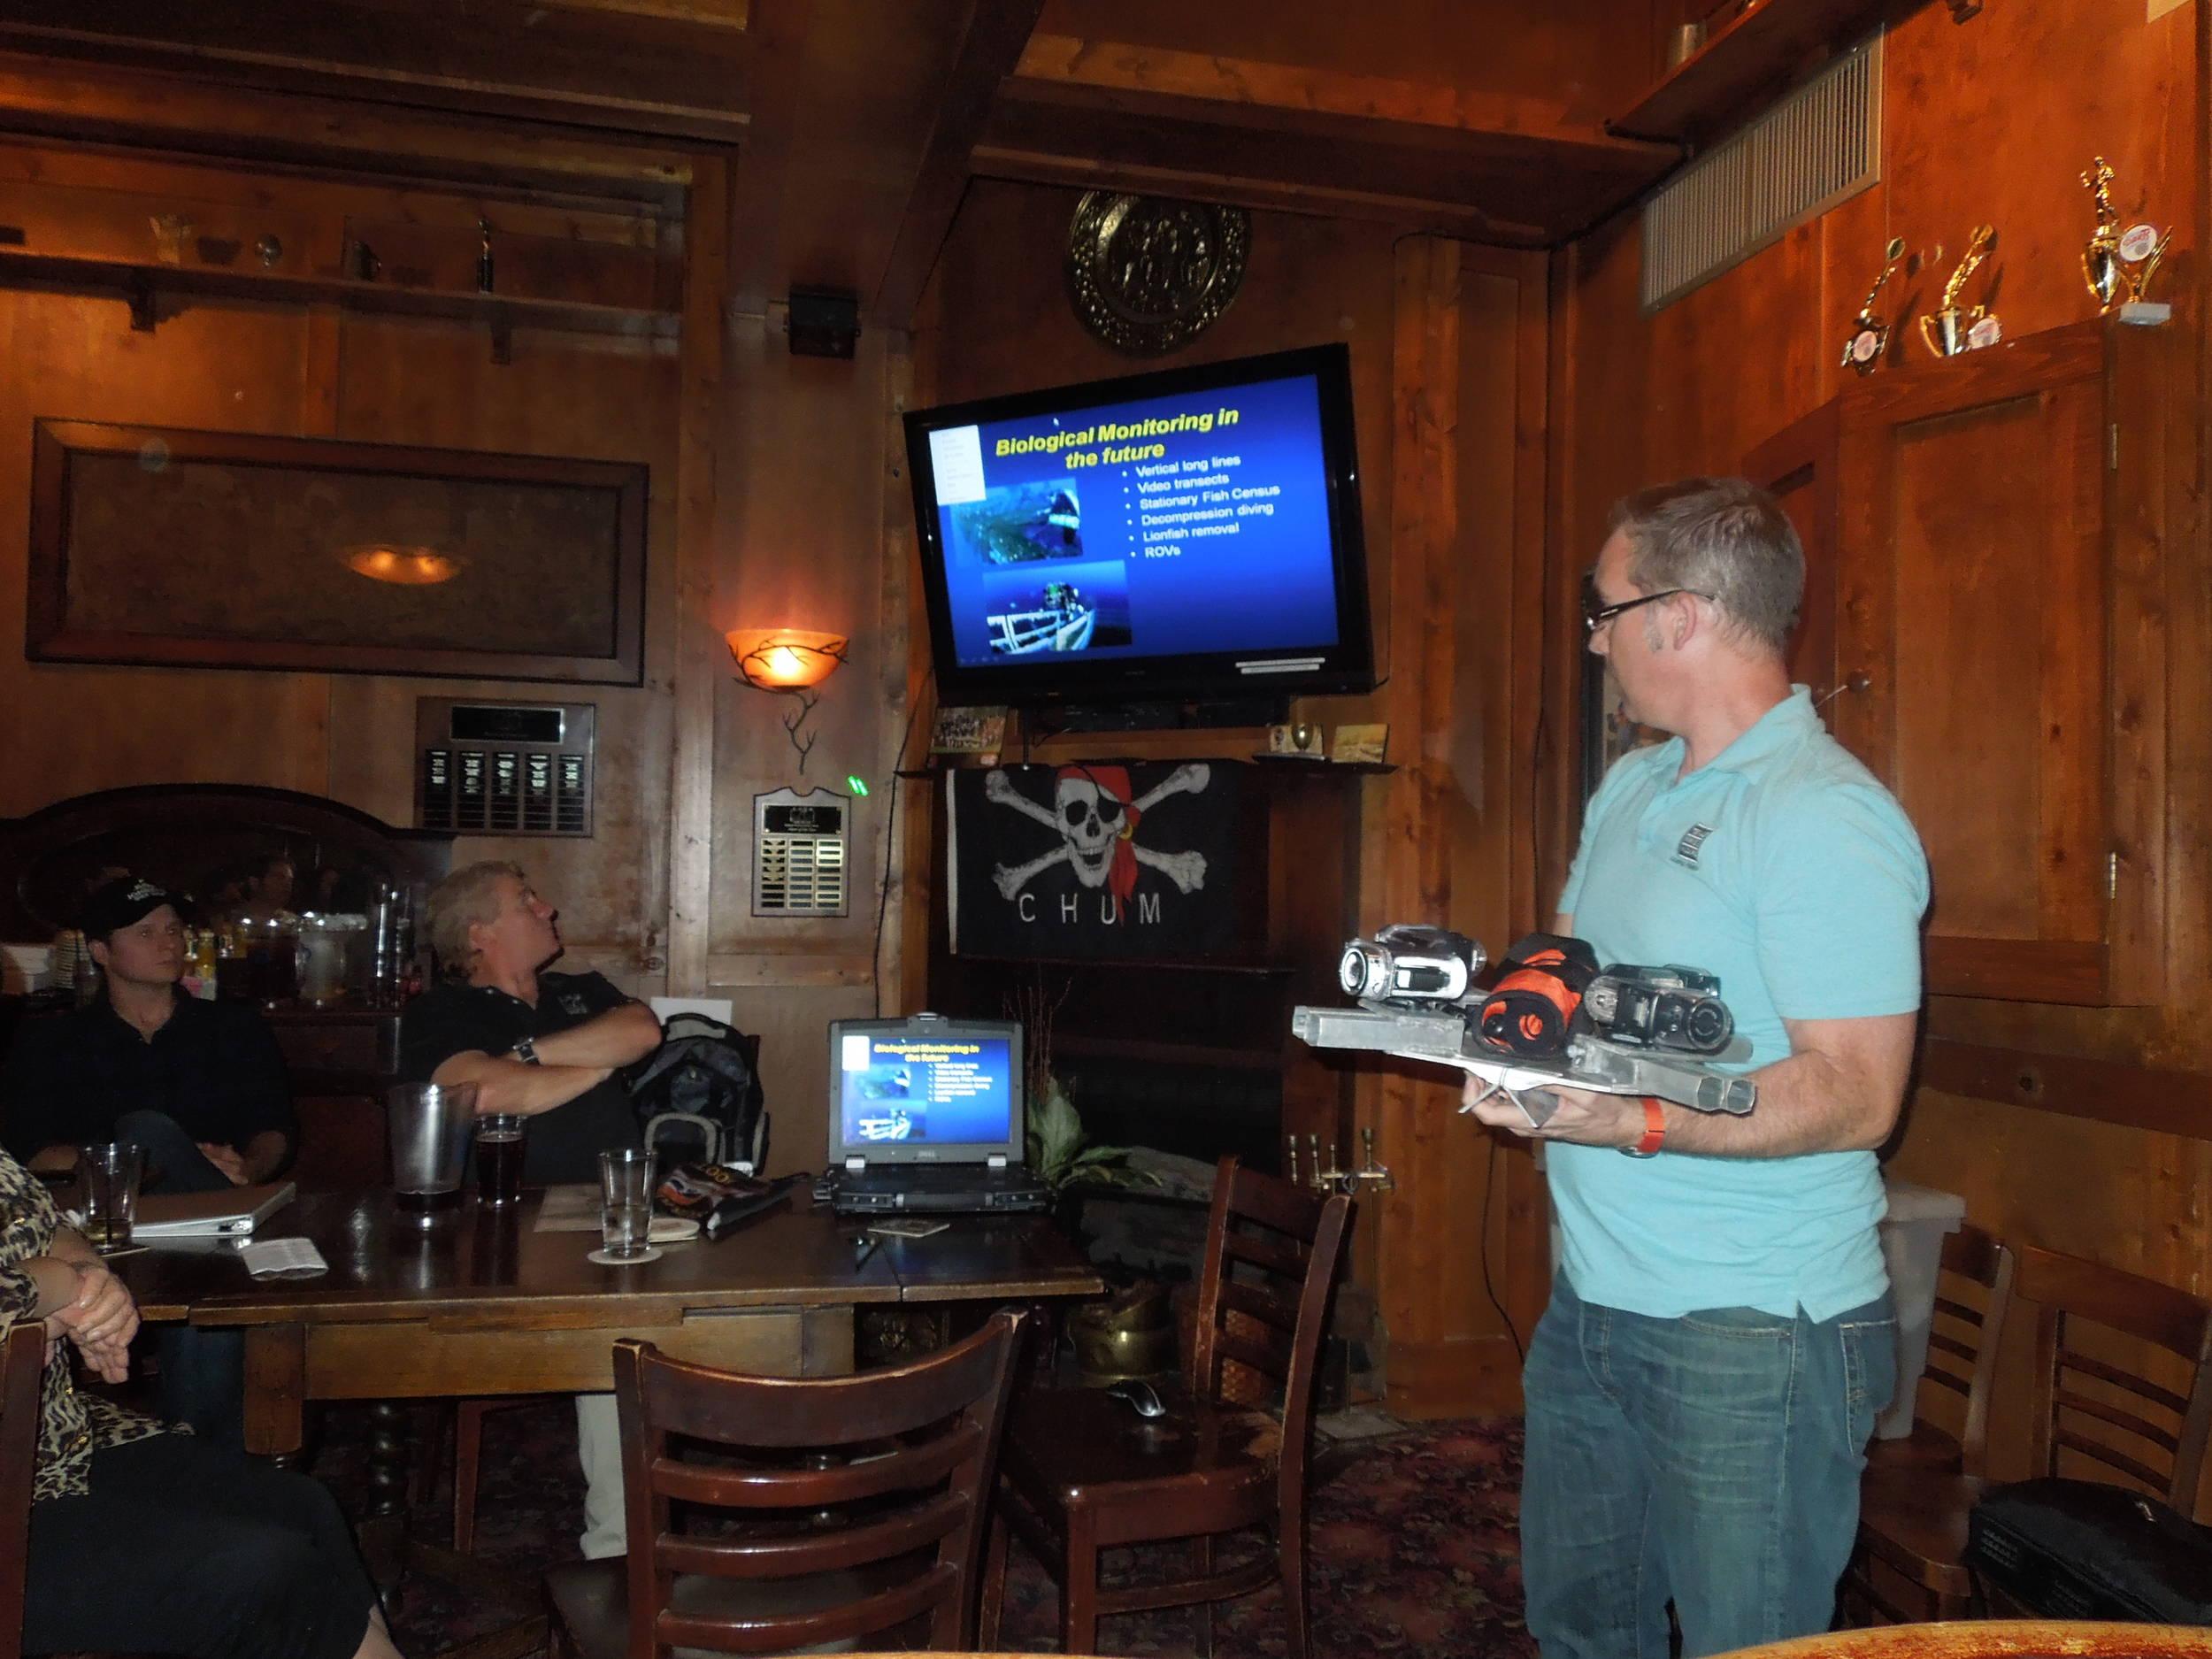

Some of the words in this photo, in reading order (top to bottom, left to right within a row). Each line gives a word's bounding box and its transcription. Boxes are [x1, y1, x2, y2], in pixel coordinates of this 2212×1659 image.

[995, 426, 1094, 457] Biological
[1098, 413, 1213, 442] Monitoring
[1217, 408, 1239, 426] in
[1065, 451, 1098, 470] the
[1102, 443, 1164, 465] future
[1135, 462, 1179, 478] Vertical
[1182, 460, 1209, 472] long
[1211, 456, 1241, 468] lines
[1137, 480, 1171, 494] Video
[1174, 473, 1230, 489] transects
[1140, 495, 1198, 511] Stationary
[1202, 489, 1229, 503] Fish
[1232, 485, 1280, 500] Census
[1141, 507, 1233, 526] Decompression
[1237, 503, 1274, 516] diving
[1143, 527, 1189, 542] Lionfish
[1192, 522, 1240, 537] removal
[1145, 545, 1181, 558] ROVs
[1019, 893, 1160, 925] CHUM
